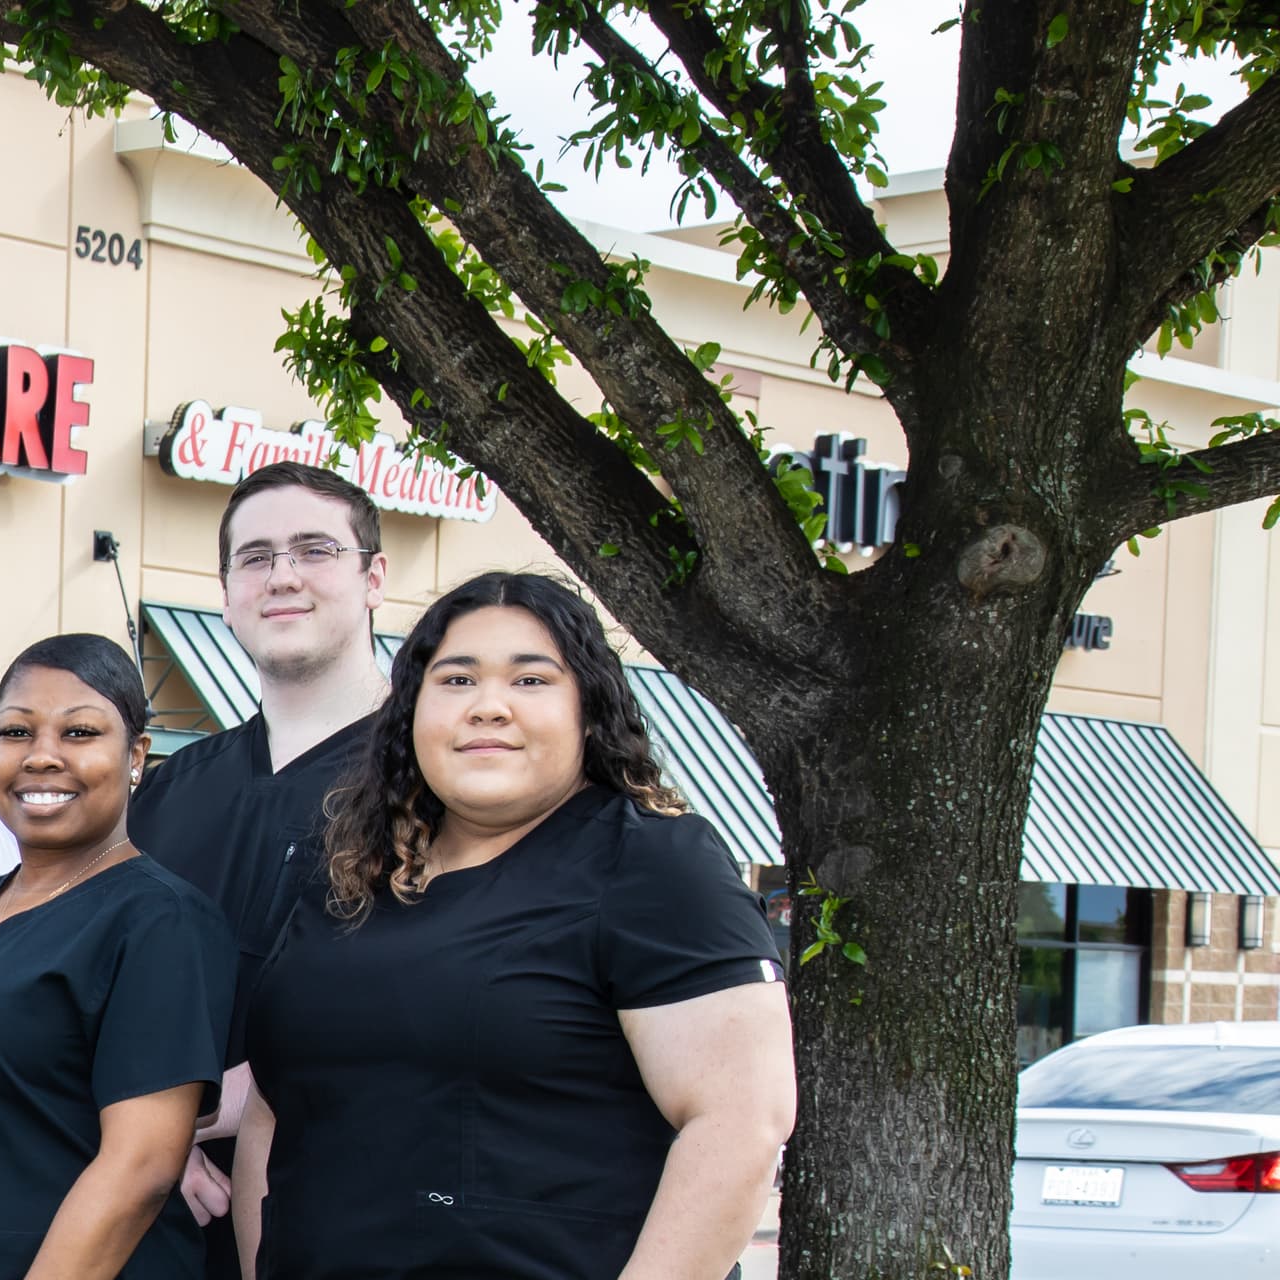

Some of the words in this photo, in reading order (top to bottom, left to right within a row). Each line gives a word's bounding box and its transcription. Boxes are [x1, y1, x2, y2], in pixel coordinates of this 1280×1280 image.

[75, 225, 144, 271] 5204
[177, 412, 209, 468] &
[221, 420, 336, 473] Famil
